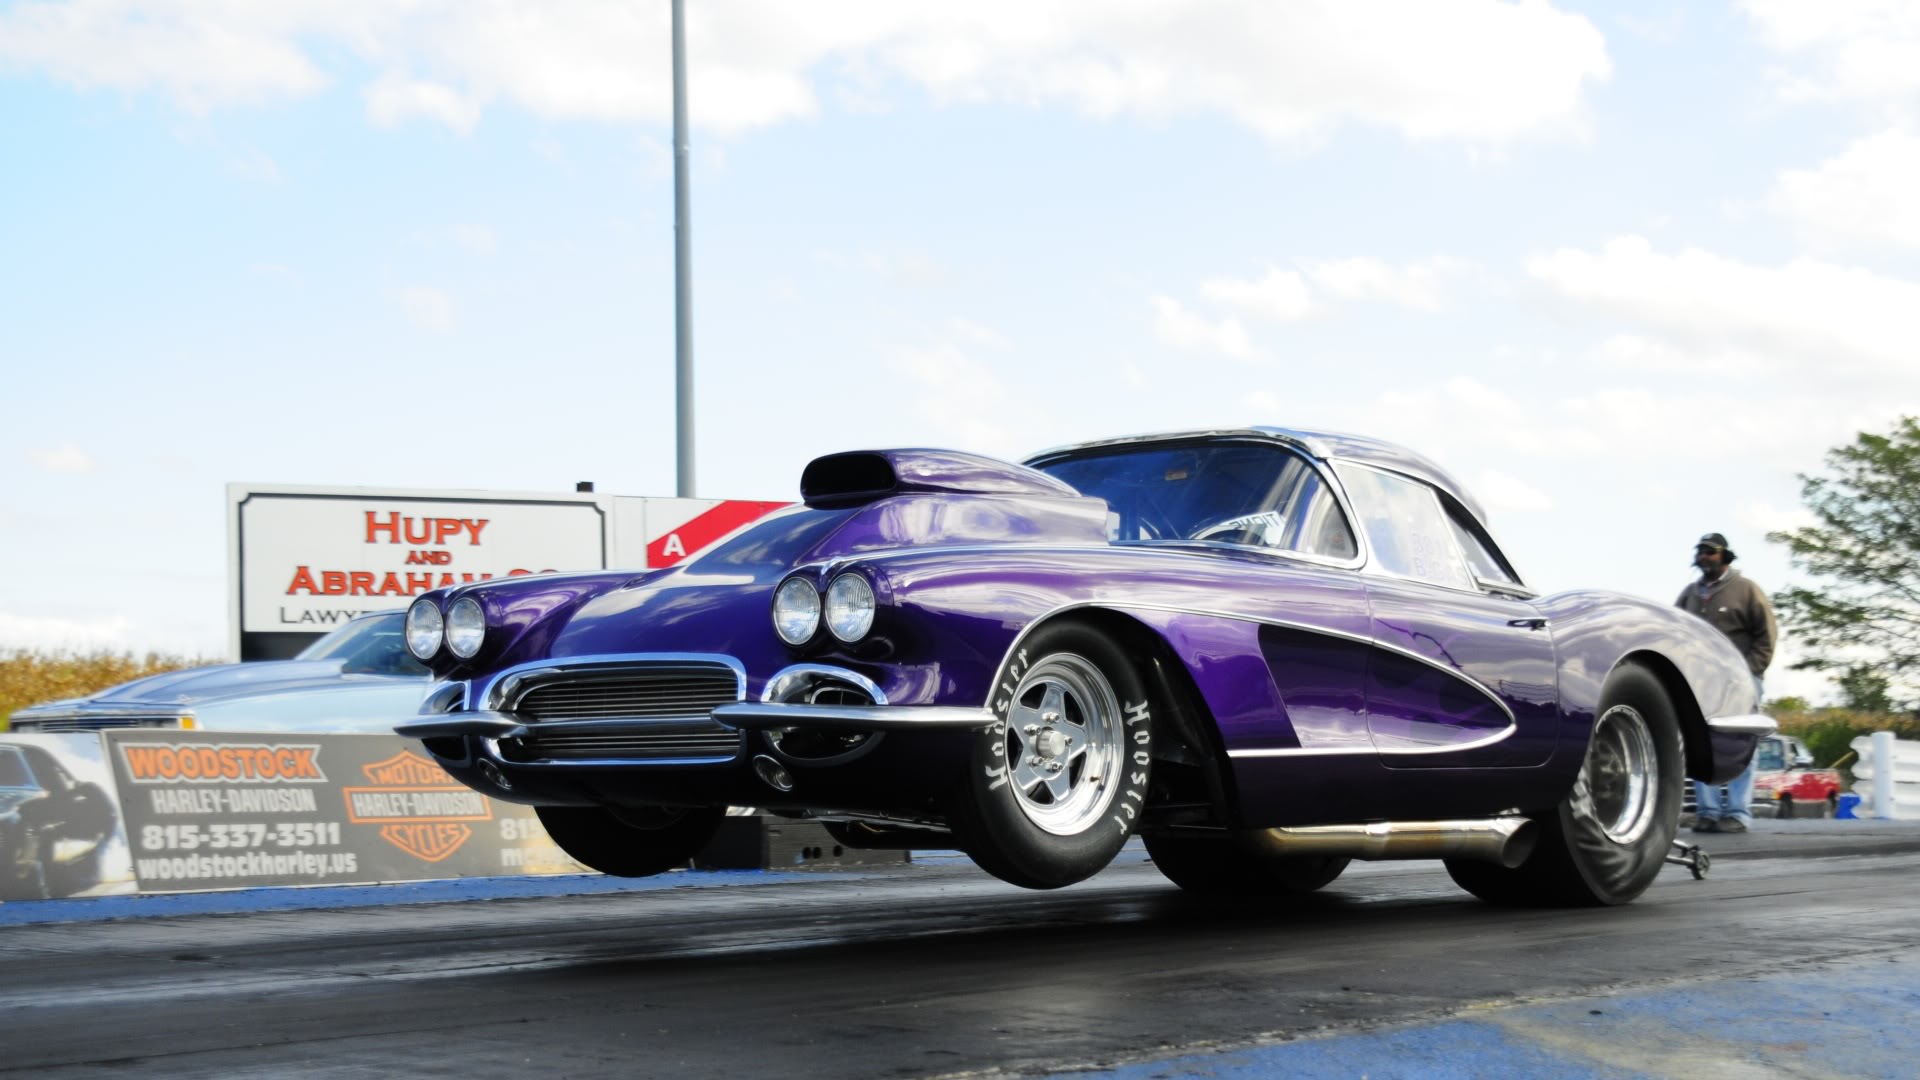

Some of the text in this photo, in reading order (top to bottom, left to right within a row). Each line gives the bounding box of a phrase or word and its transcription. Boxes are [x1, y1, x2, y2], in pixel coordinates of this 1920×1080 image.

[364, 511, 490, 546] HUPY
[405, 550, 453, 565] AND
[662, 533, 687, 556] A
[126, 746, 322, 780] WOODSTOCK
[151, 788, 318, 814] HARLEY-DAVIDSON
[351, 792, 486, 817] HARLEY-DAVIDSON
[142, 821, 341, 850] 815-337-3511
[389, 823, 462, 855] CYCLES
[136, 850, 358, 880] woodstockharley.us
